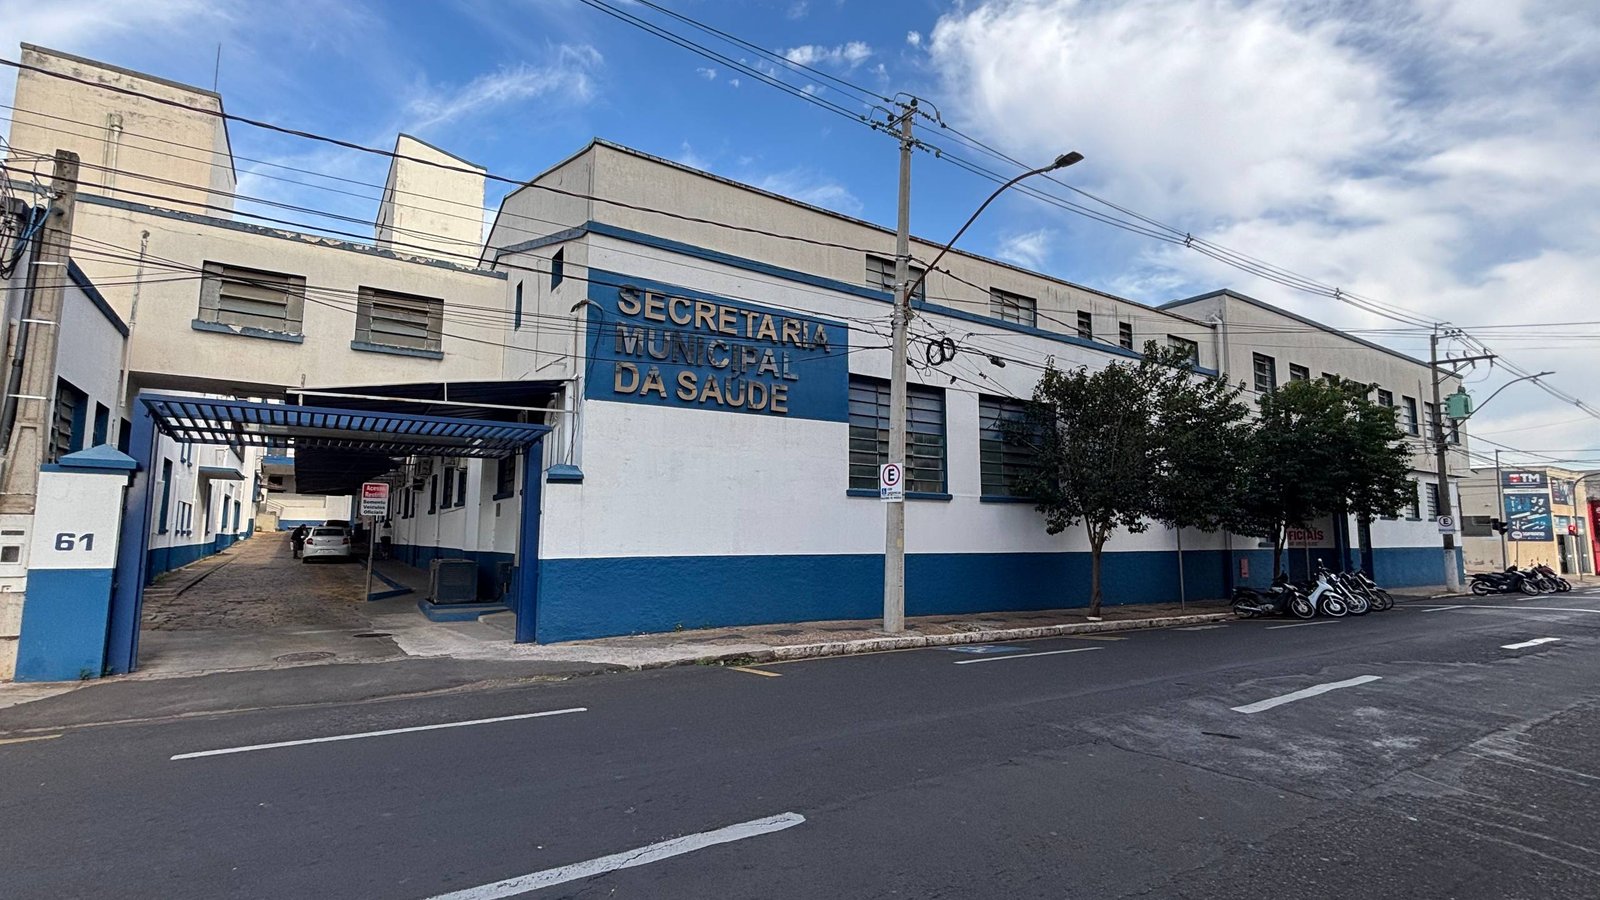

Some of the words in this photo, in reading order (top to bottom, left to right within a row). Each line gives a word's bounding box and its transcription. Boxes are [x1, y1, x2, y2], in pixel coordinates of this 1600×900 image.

[617, 284, 831, 353] SECRETARIA
[615, 321, 799, 382] MUNICIPAL
[614, 361, 667, 398] DA
[676, 371, 789, 413] SAÚDE
[888, 469, 895, 482] E
[55, 532, 95, 551] 61
